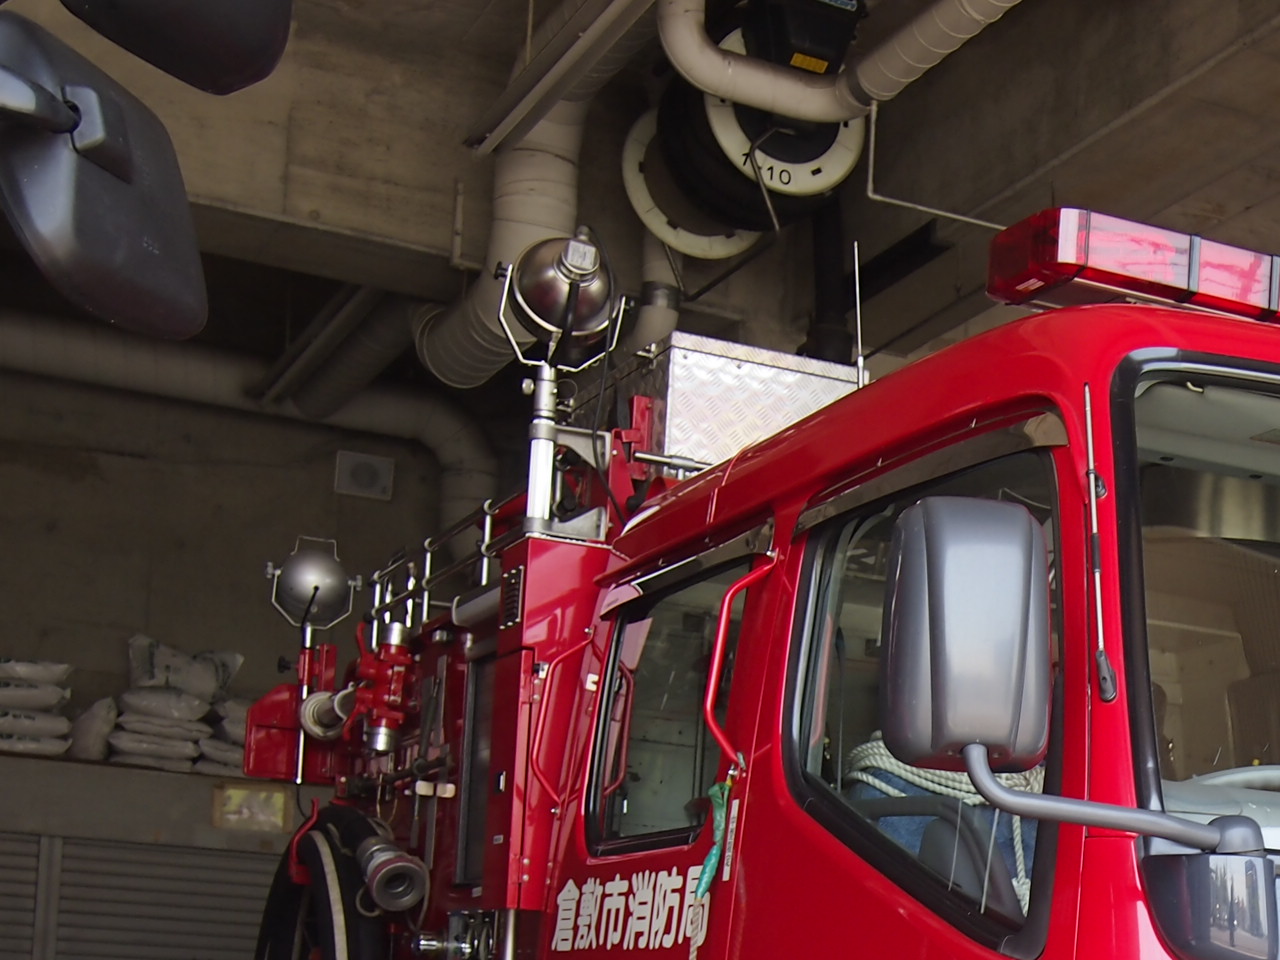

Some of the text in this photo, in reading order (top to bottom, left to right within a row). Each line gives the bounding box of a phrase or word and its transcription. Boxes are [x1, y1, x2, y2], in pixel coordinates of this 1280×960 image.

[551, 865, 711, 951] 倉敷市消防局
